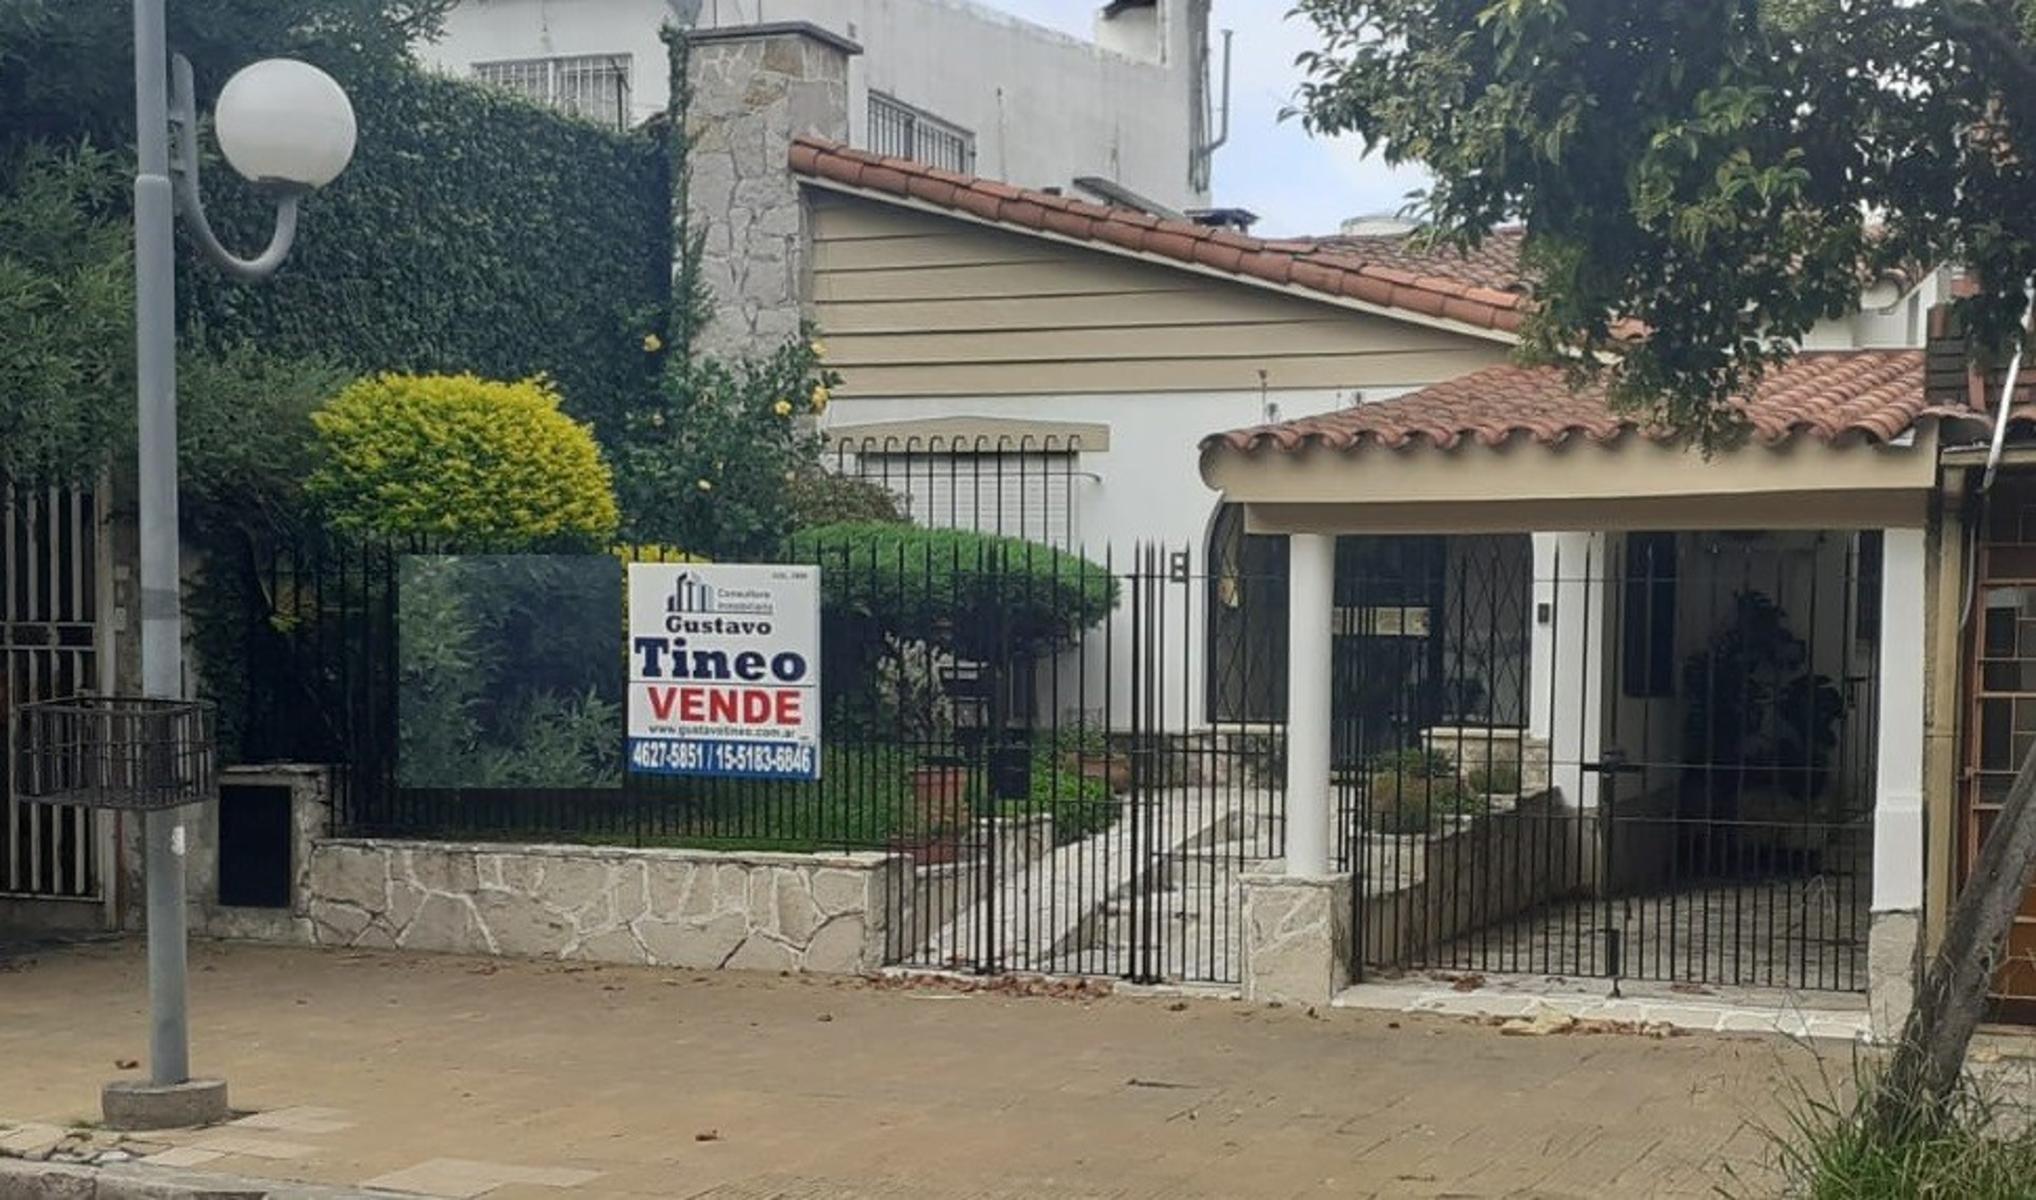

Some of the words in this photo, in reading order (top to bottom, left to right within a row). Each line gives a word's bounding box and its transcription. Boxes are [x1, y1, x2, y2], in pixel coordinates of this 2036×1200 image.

[665, 615, 772, 635] Gustavo
[634, 637, 807, 681] Tineo
[647, 687, 801, 725] VENDE
